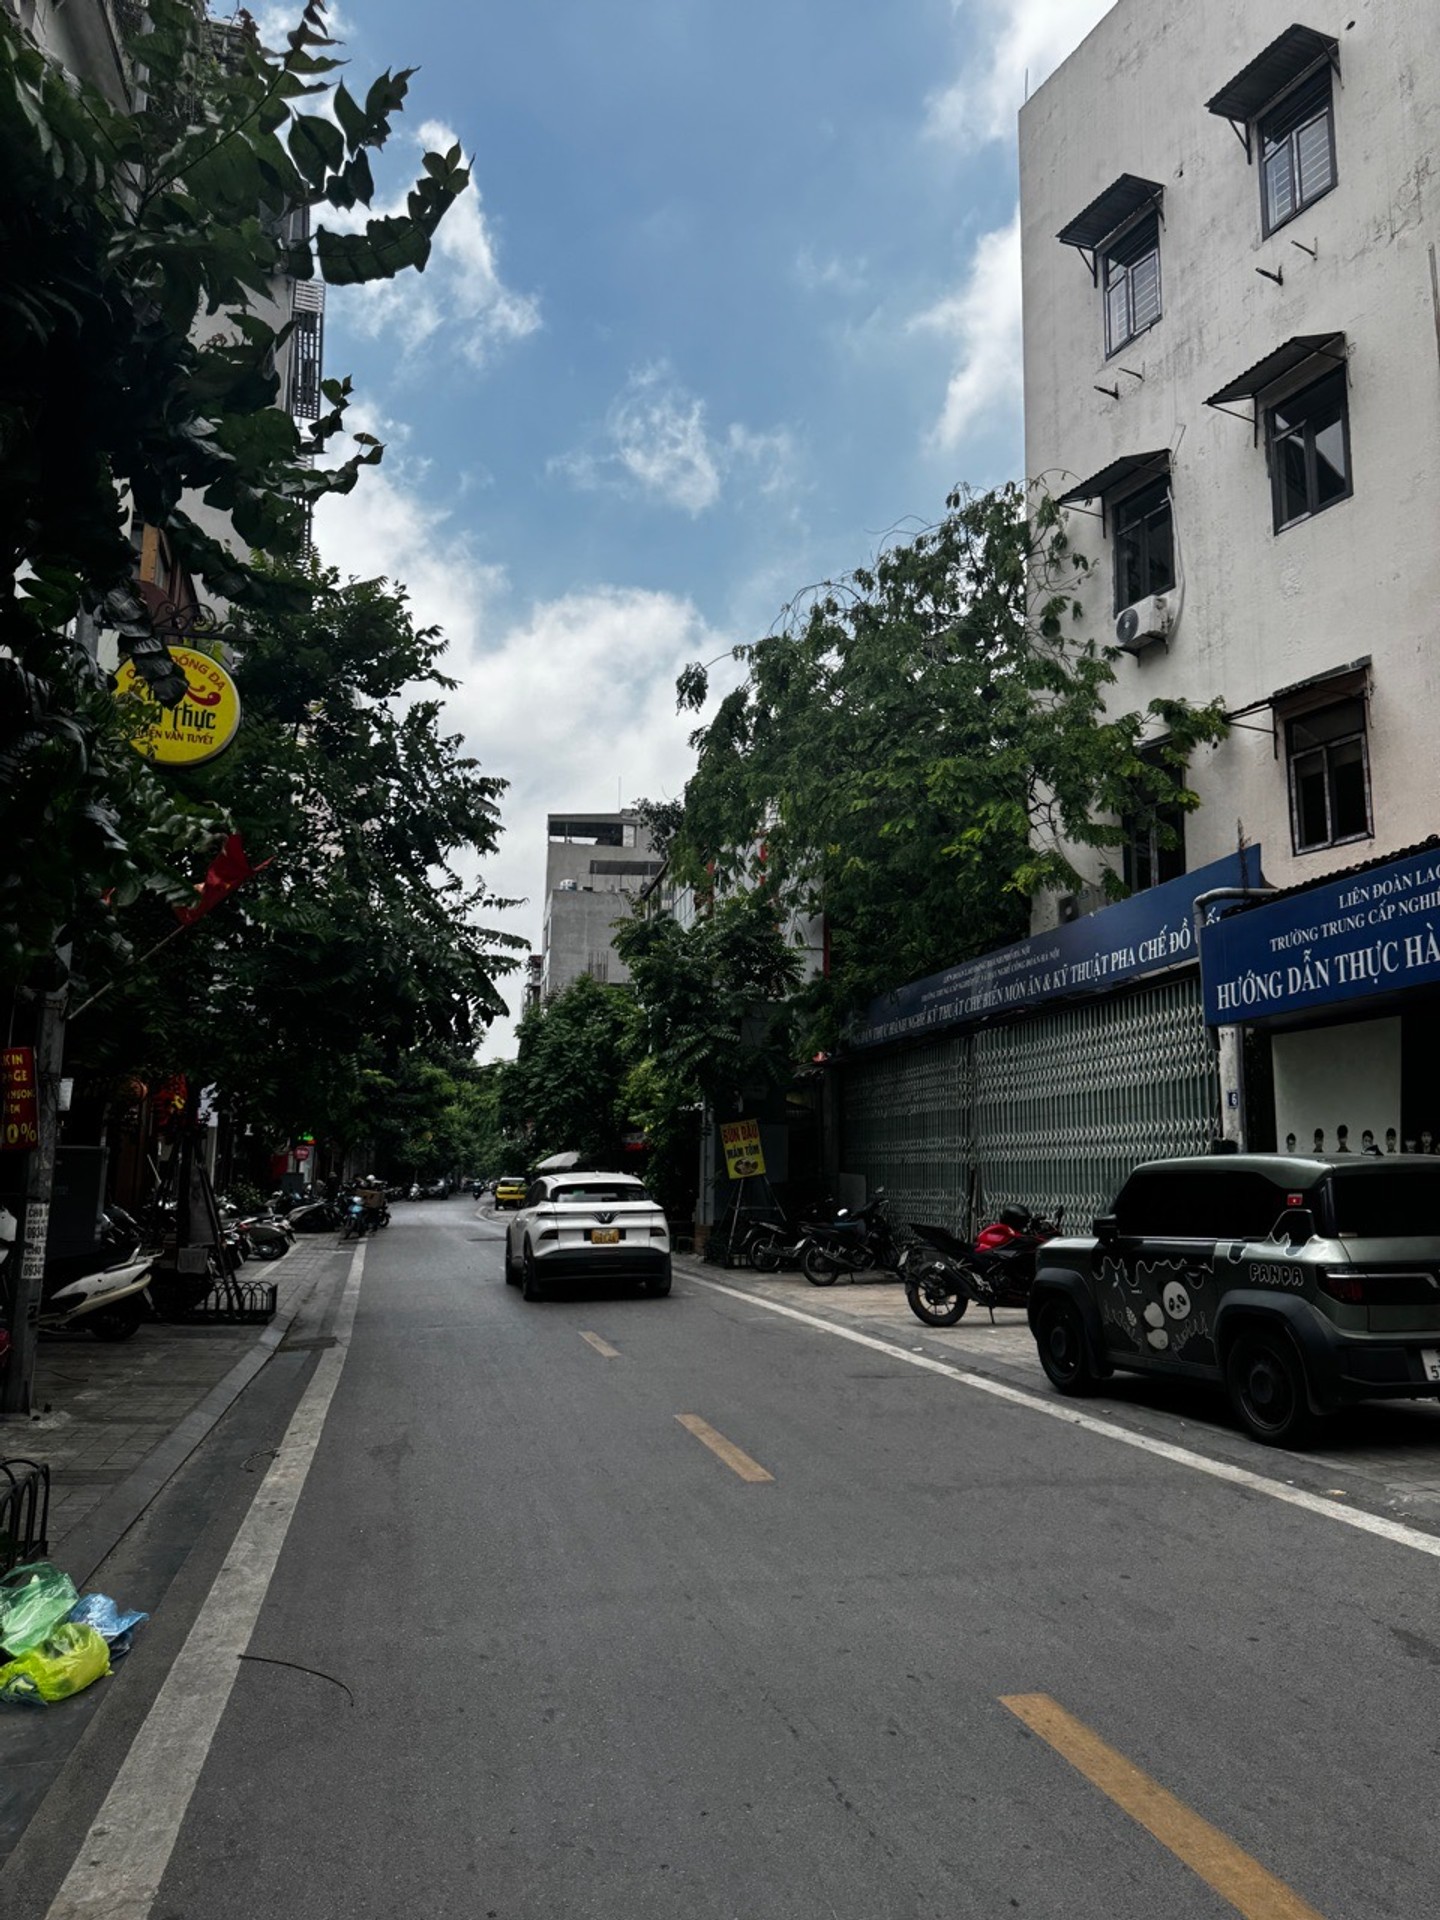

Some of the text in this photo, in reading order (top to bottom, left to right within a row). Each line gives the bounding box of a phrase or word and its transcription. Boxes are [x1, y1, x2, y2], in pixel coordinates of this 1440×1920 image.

[1338, 886, 1370, 910] LIÊN
[1372, 872, 1413, 900] ĐOÀN
[1269, 926, 1319, 952] TRƯỜNG
[1320, 913, 1366, 938] TRUNG
[1367, 899, 1397, 925] CẤP
[938, 997, 964, 1022] THUẬT
[964, 986, 983, 1014] CHẾ
[982, 981, 1004, 1009] BIẾN
[1004, 978, 1026, 1004] MÓN
[1042, 974, 1052, 991] &
[1071, 951, 1110, 983] THUẬT
[1111, 946, 1137, 973] PHA
[1138, 924, 1168, 963] CHẾ
[1169, 917, 1192, 954] ĐỒ
[1216, 969, 1284, 1011] HƯỚNG
[1287, 948, 1331, 995] DẪN
[1334, 940, 1398, 985] THỰC
[1249, 1262, 1304, 1287] PANDA
